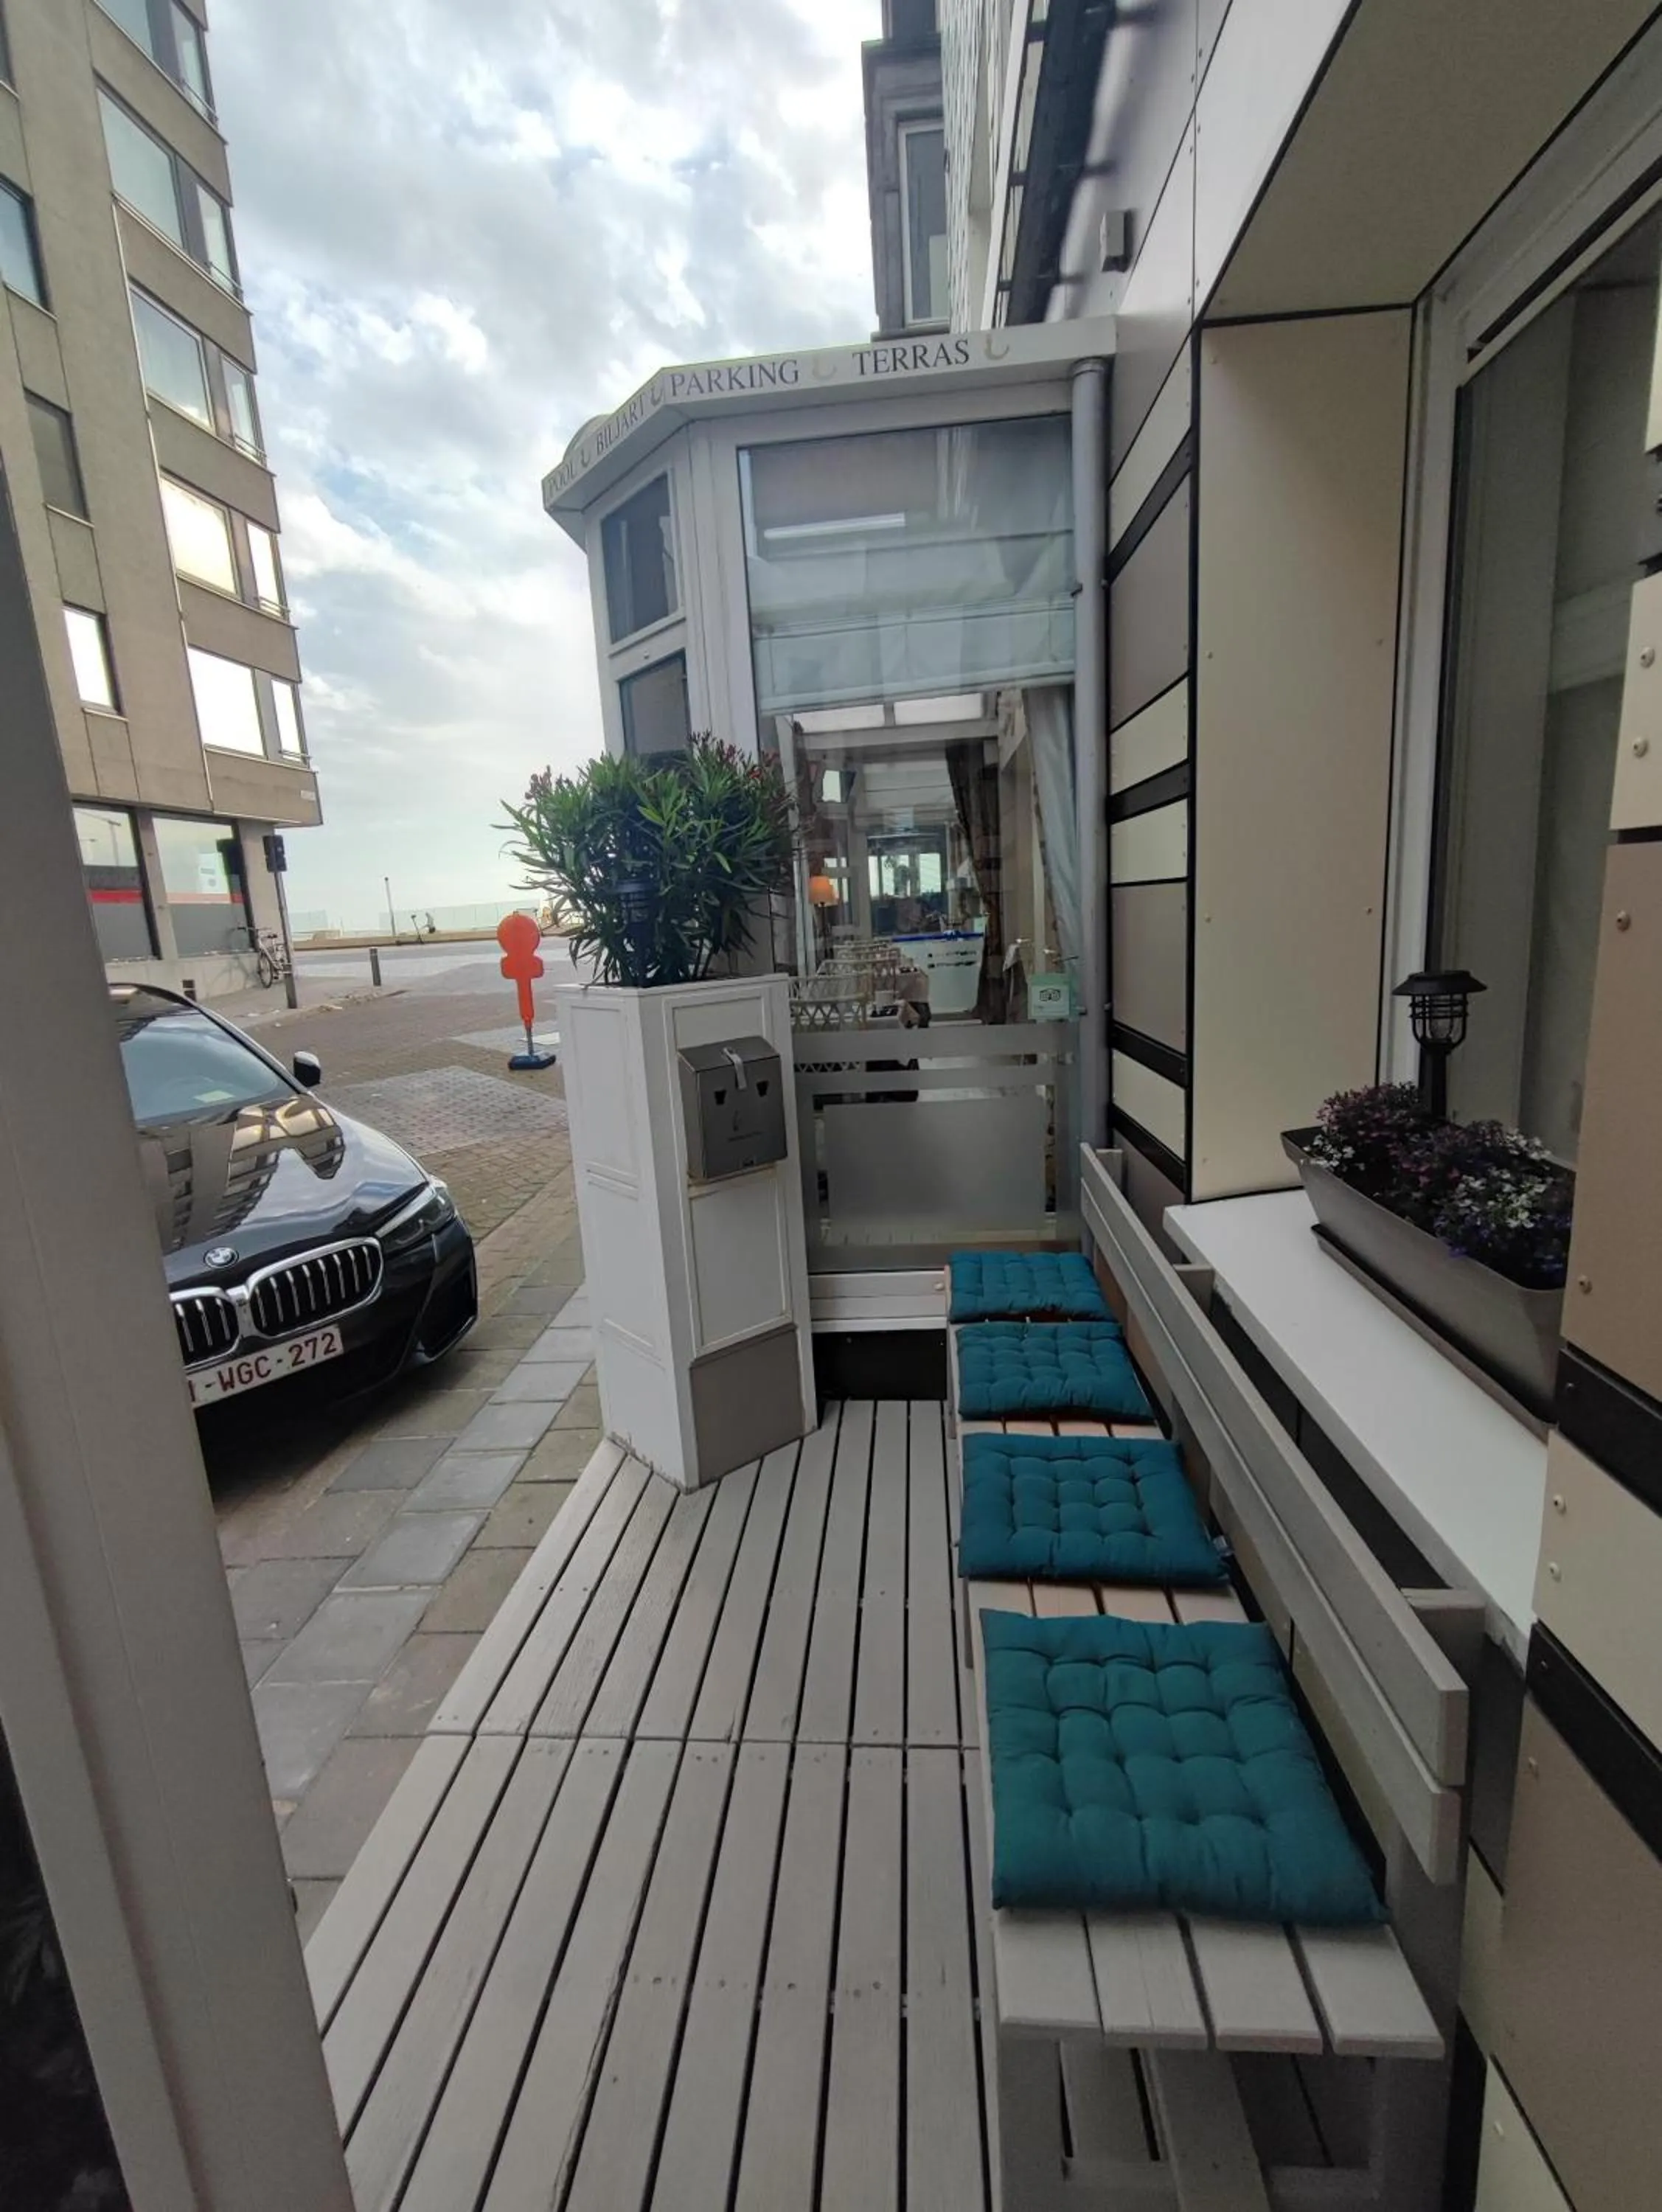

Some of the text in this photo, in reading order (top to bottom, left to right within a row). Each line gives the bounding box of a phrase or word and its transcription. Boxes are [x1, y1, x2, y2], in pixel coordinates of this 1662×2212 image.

[670, 338, 970, 397] PARKING TERRAS
[596, 390, 650, 456] BILJART
